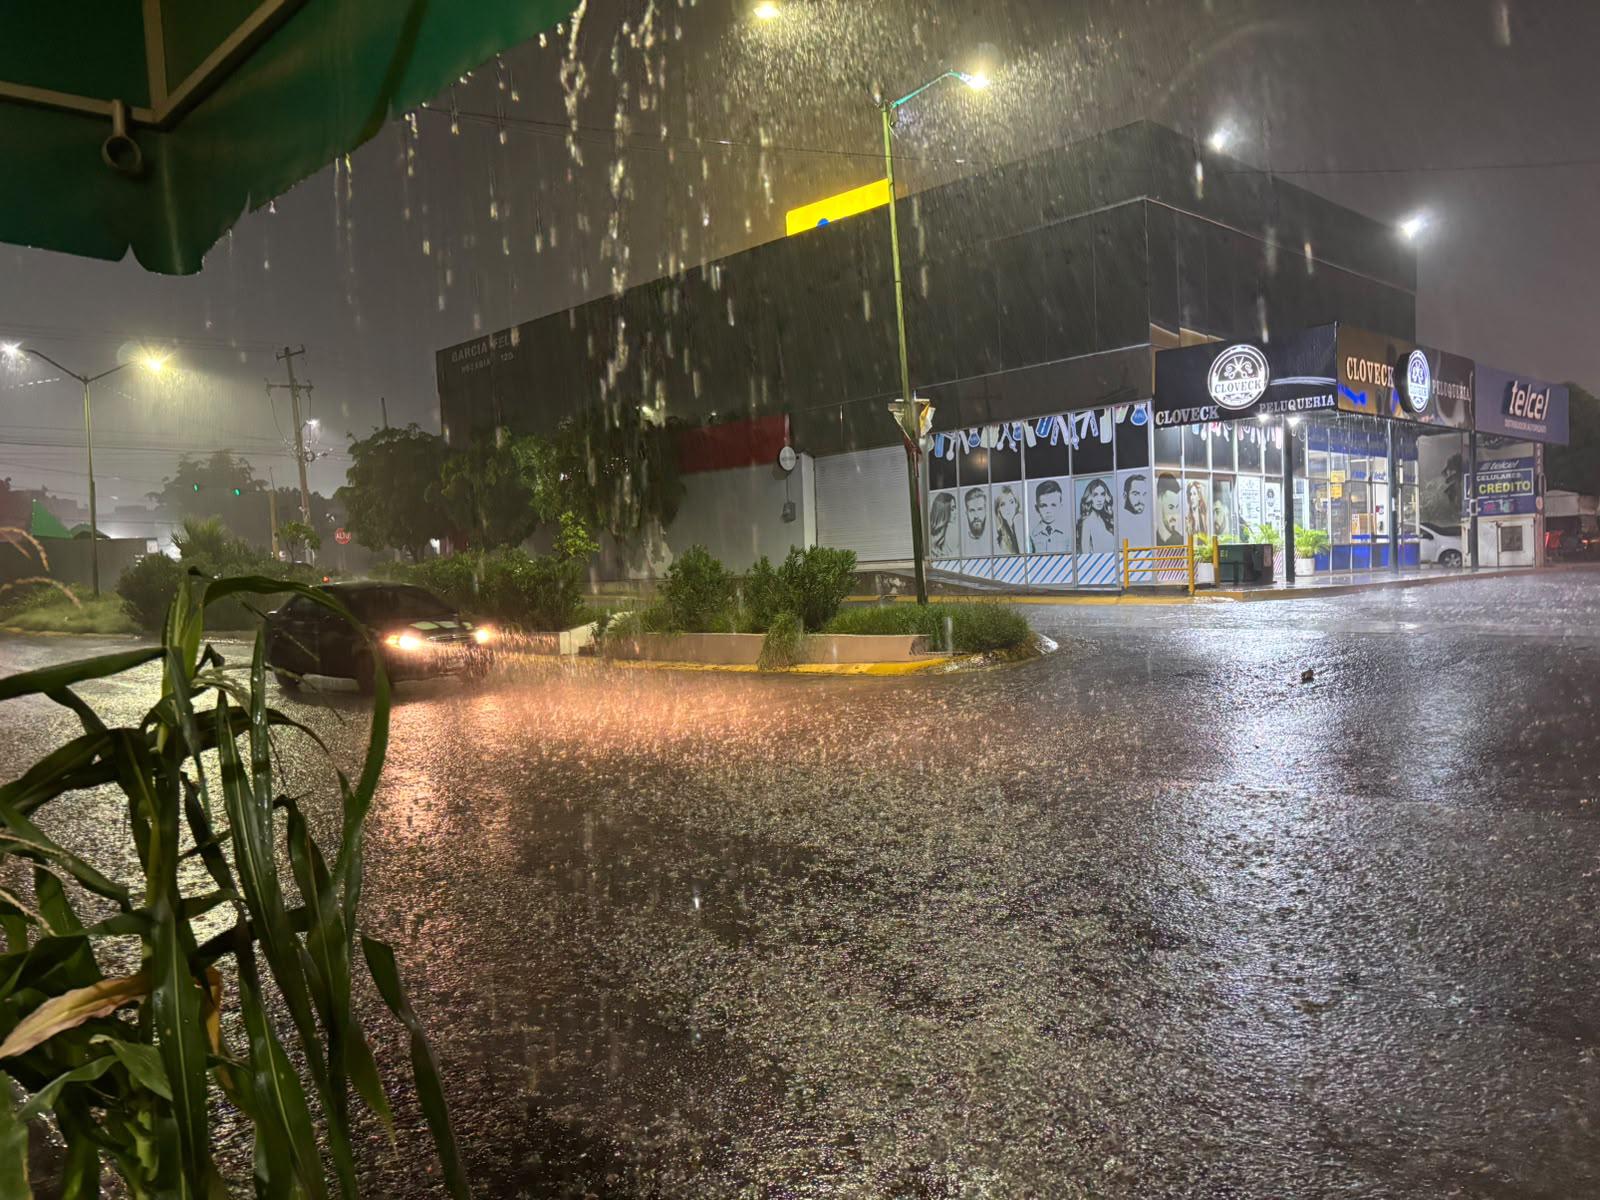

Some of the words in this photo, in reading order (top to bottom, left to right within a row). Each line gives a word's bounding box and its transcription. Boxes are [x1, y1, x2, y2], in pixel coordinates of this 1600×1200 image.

[451, 342, 488, 362] GARCIA
[1346, 356, 1394, 388] CLOVECK
[1214, 379, 1262, 394] CLOVECK
[1432, 379, 1472, 401] PELUQUERIA
[1509, 380, 1550, 420] telcel
[1155, 405, 1220, 426] CLOVECK
[1259, 394, 1336, 413] PELUQUERIA
